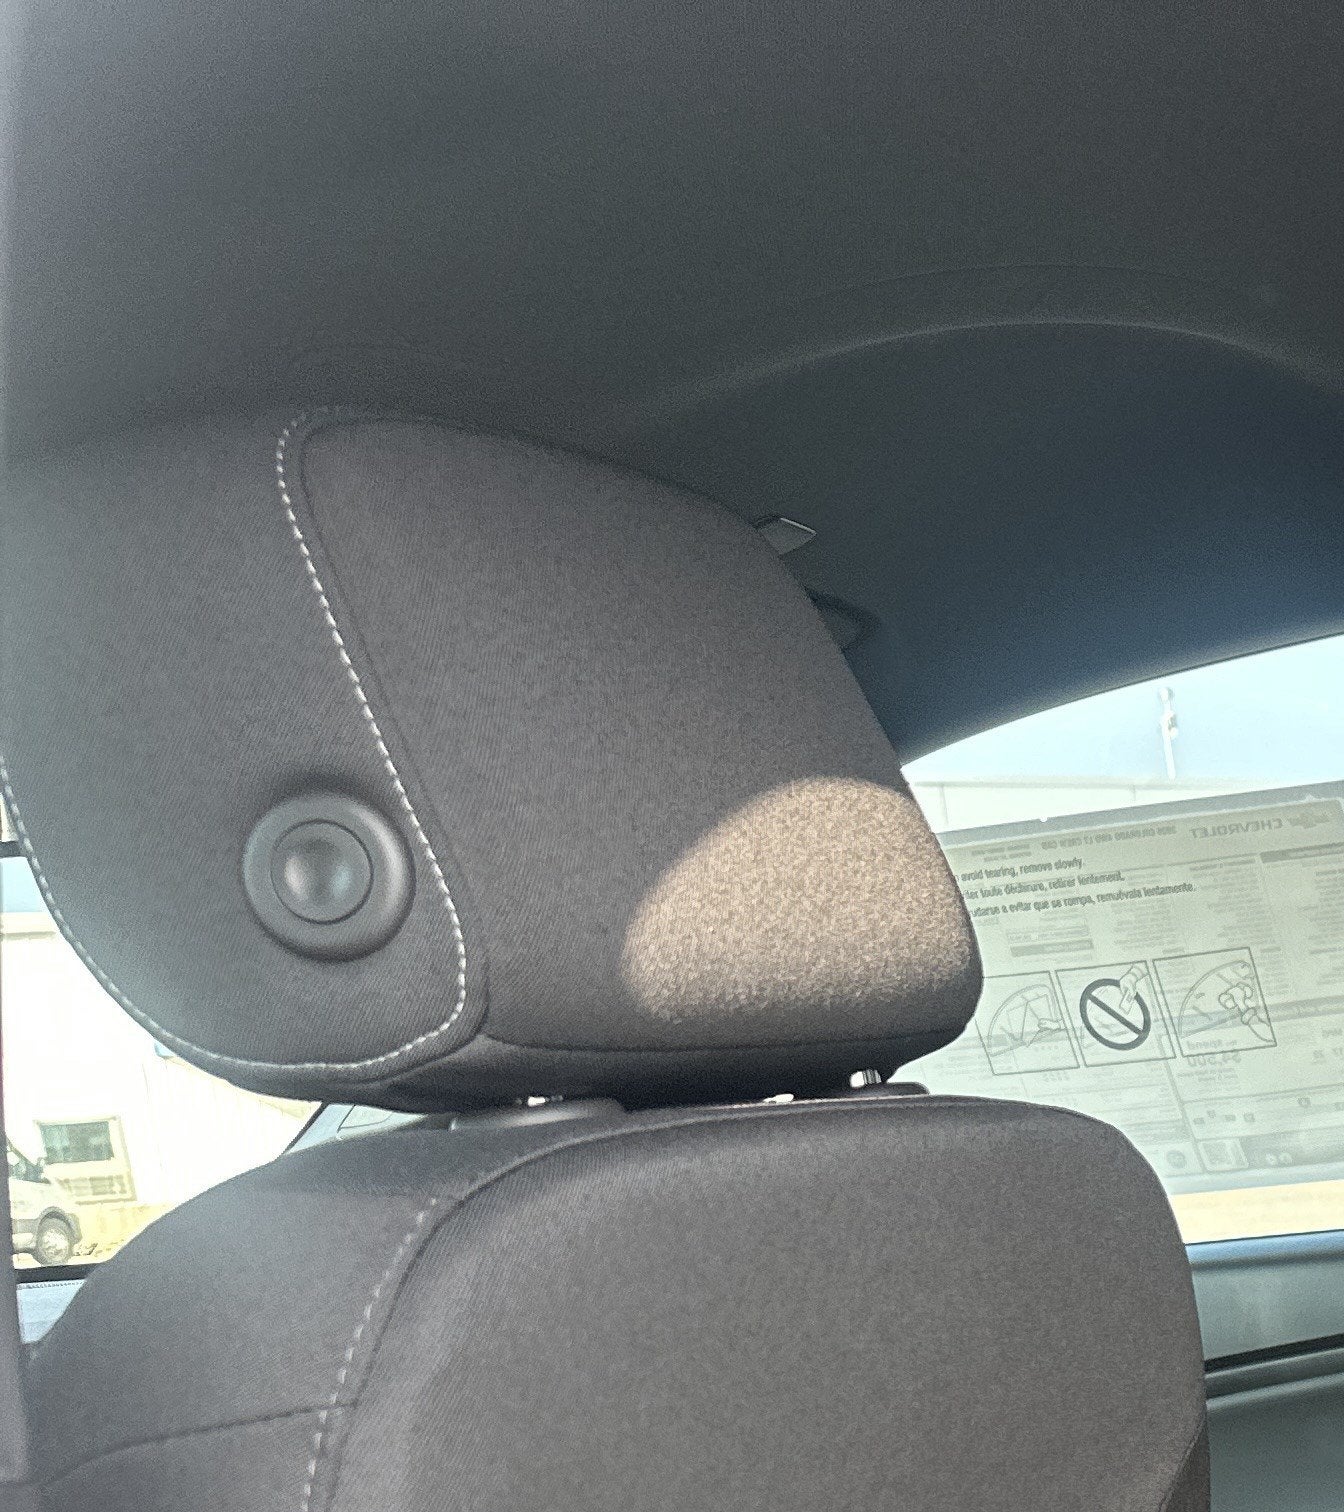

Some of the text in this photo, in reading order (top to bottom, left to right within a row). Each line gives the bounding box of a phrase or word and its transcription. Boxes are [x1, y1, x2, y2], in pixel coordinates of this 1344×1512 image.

[961, 869, 984, 881] avoid
[985, 866, 1018, 878] tearing,
[1020, 862, 1053, 874] remove
[980, 886, 1002, 898] toute
[1048, 878, 1076, 889] retirer
[1001, 904, 1008, 913] a
[1009, 902, 1031, 912] evitar
[1033, 900, 1049, 911] que
[1051, 899, 1062, 908] se
[1063, 895, 1095, 907] rompa,
